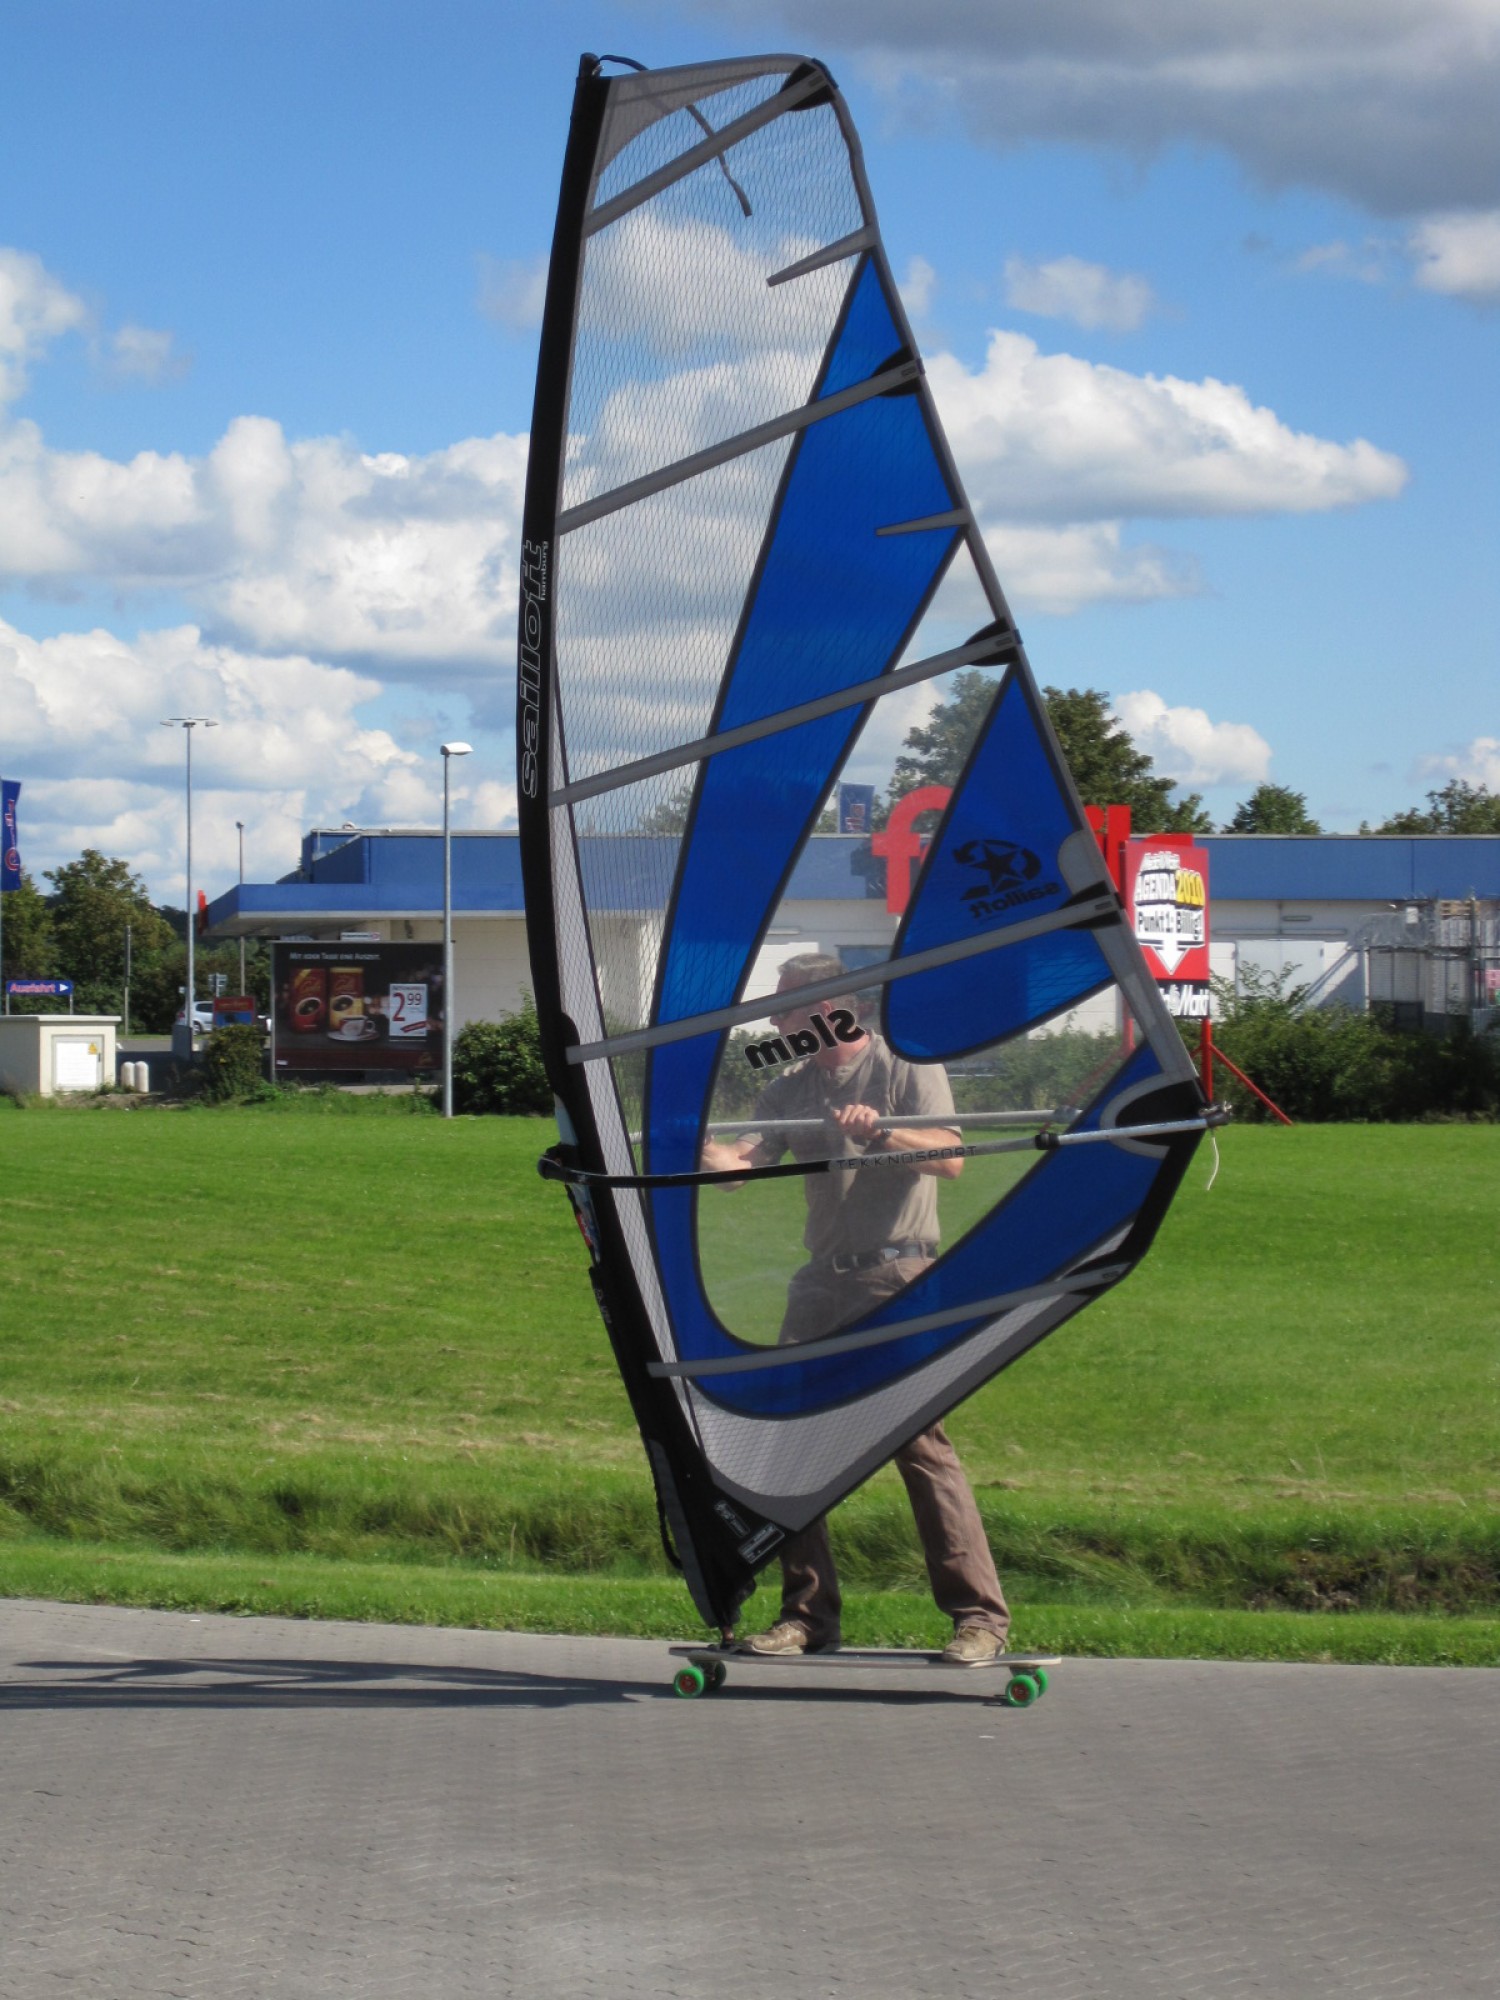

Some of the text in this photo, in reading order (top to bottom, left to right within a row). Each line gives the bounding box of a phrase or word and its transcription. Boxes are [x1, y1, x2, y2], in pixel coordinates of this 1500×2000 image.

[540, 540, 549, 601] hamburg
[520, 540, 542, 799] sailloft
[1134, 868, 1206, 907] AGENDA 2010
[836, 1145, 977, 1168] TEKKNOSPORT
